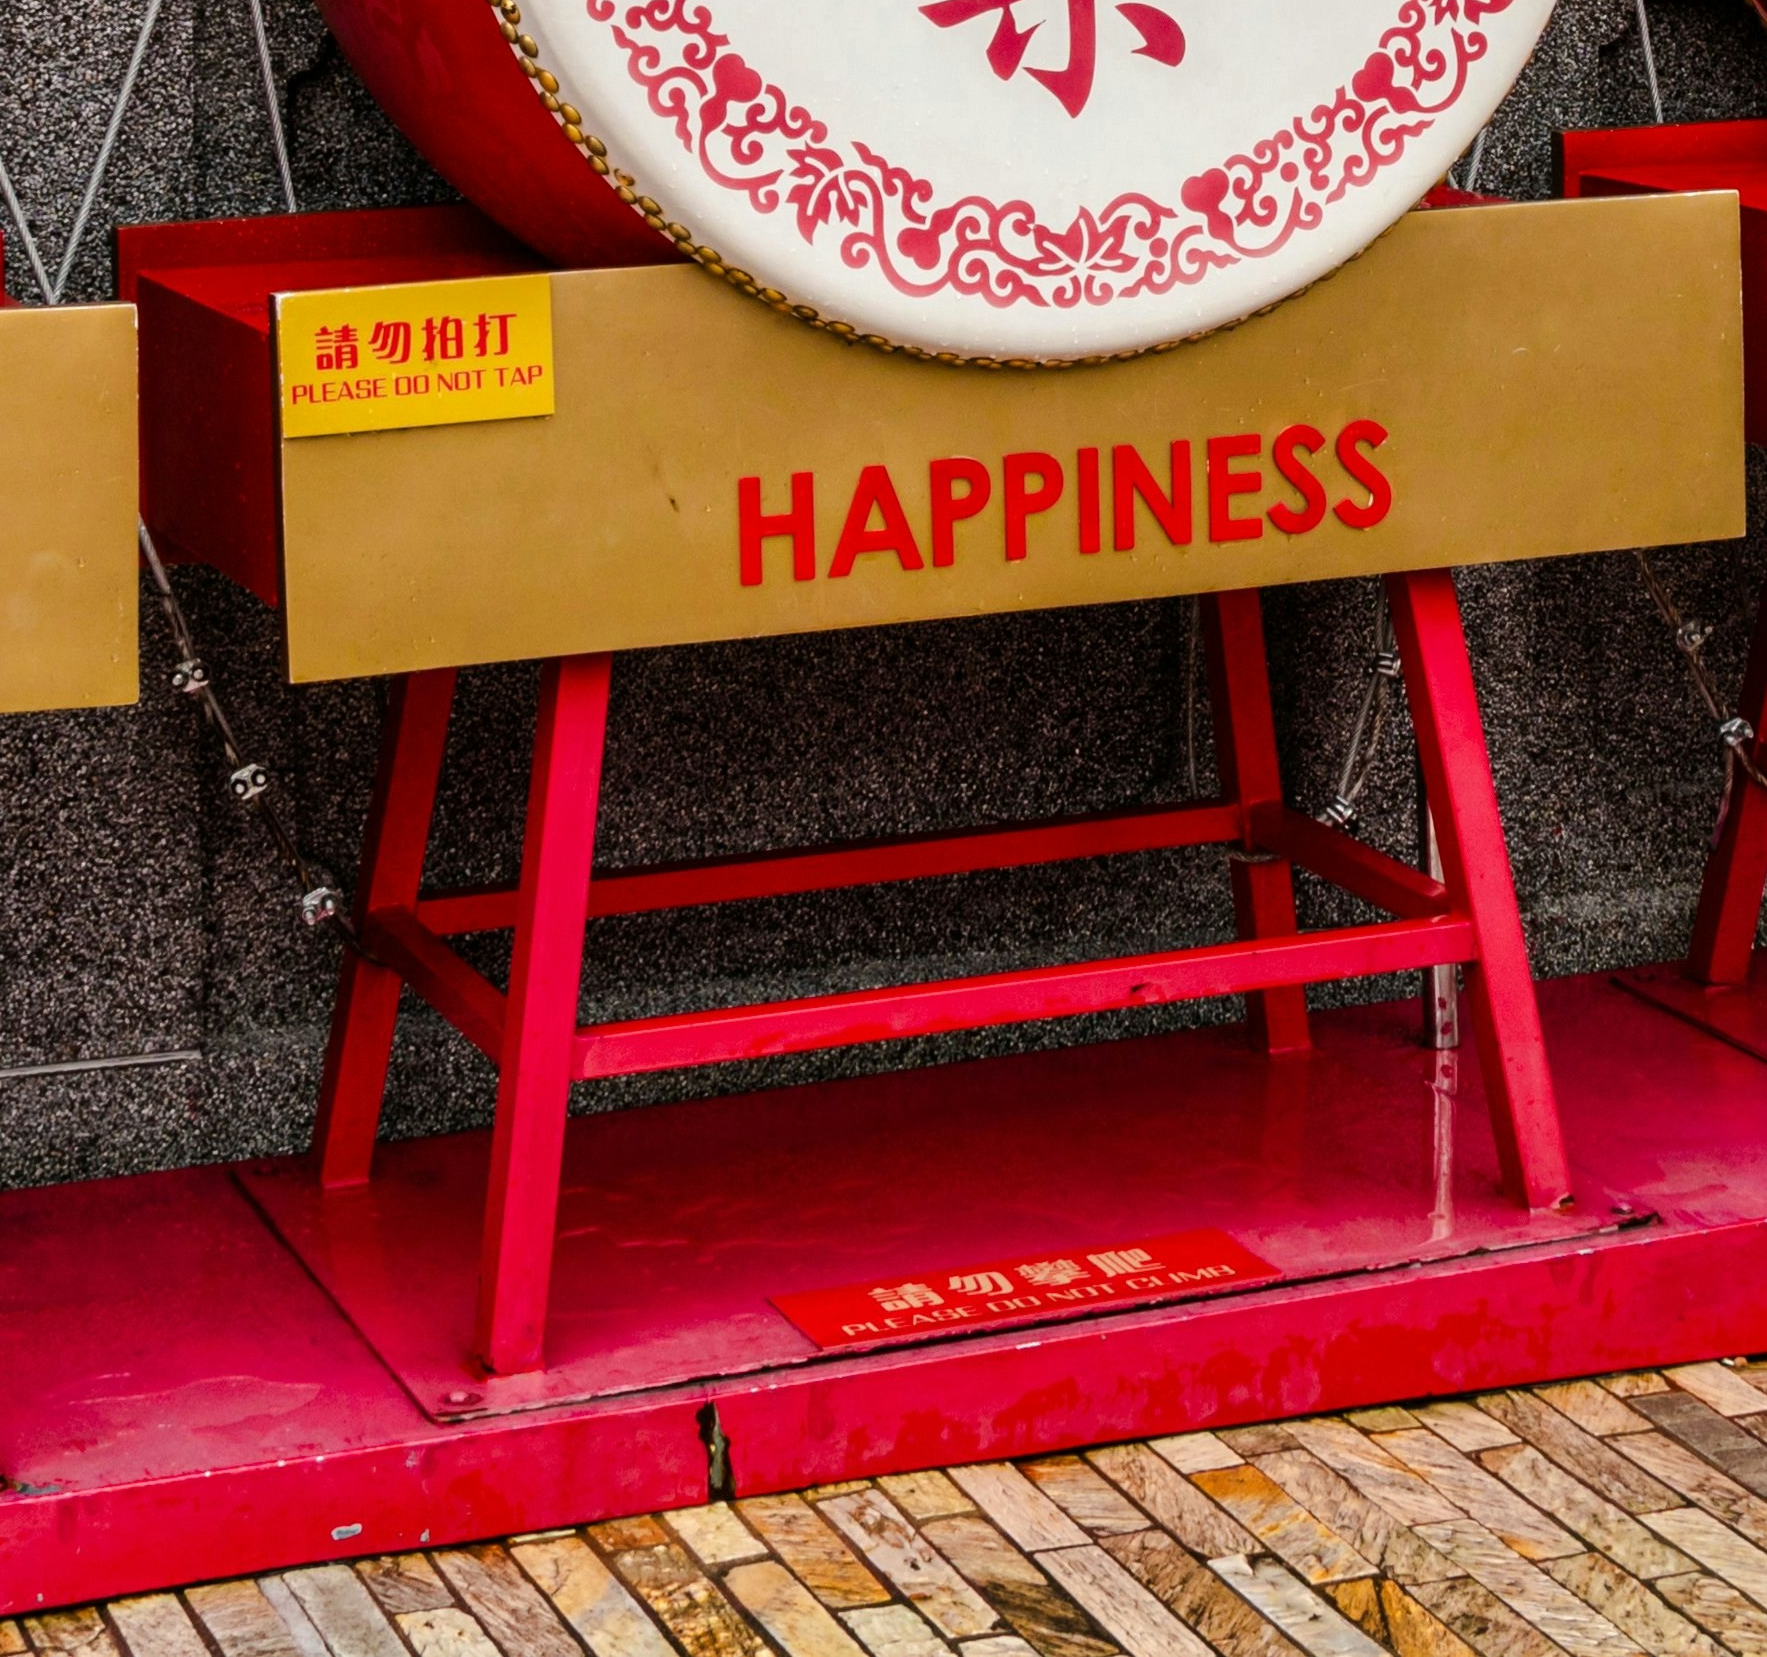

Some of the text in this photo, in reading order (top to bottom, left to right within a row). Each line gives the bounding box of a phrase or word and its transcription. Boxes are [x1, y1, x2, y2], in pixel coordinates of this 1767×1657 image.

[314, 313, 517, 371] 請勿拍打
[292, 365, 543, 405] PLEASE DO NOT TAP
[738, 419, 1392, 586] HAPPINESS
[841, 1264, 1236, 1336] PLEASE DO NOT CLIMB
[867, 1248, 1167, 1312] 請勿攀爬
